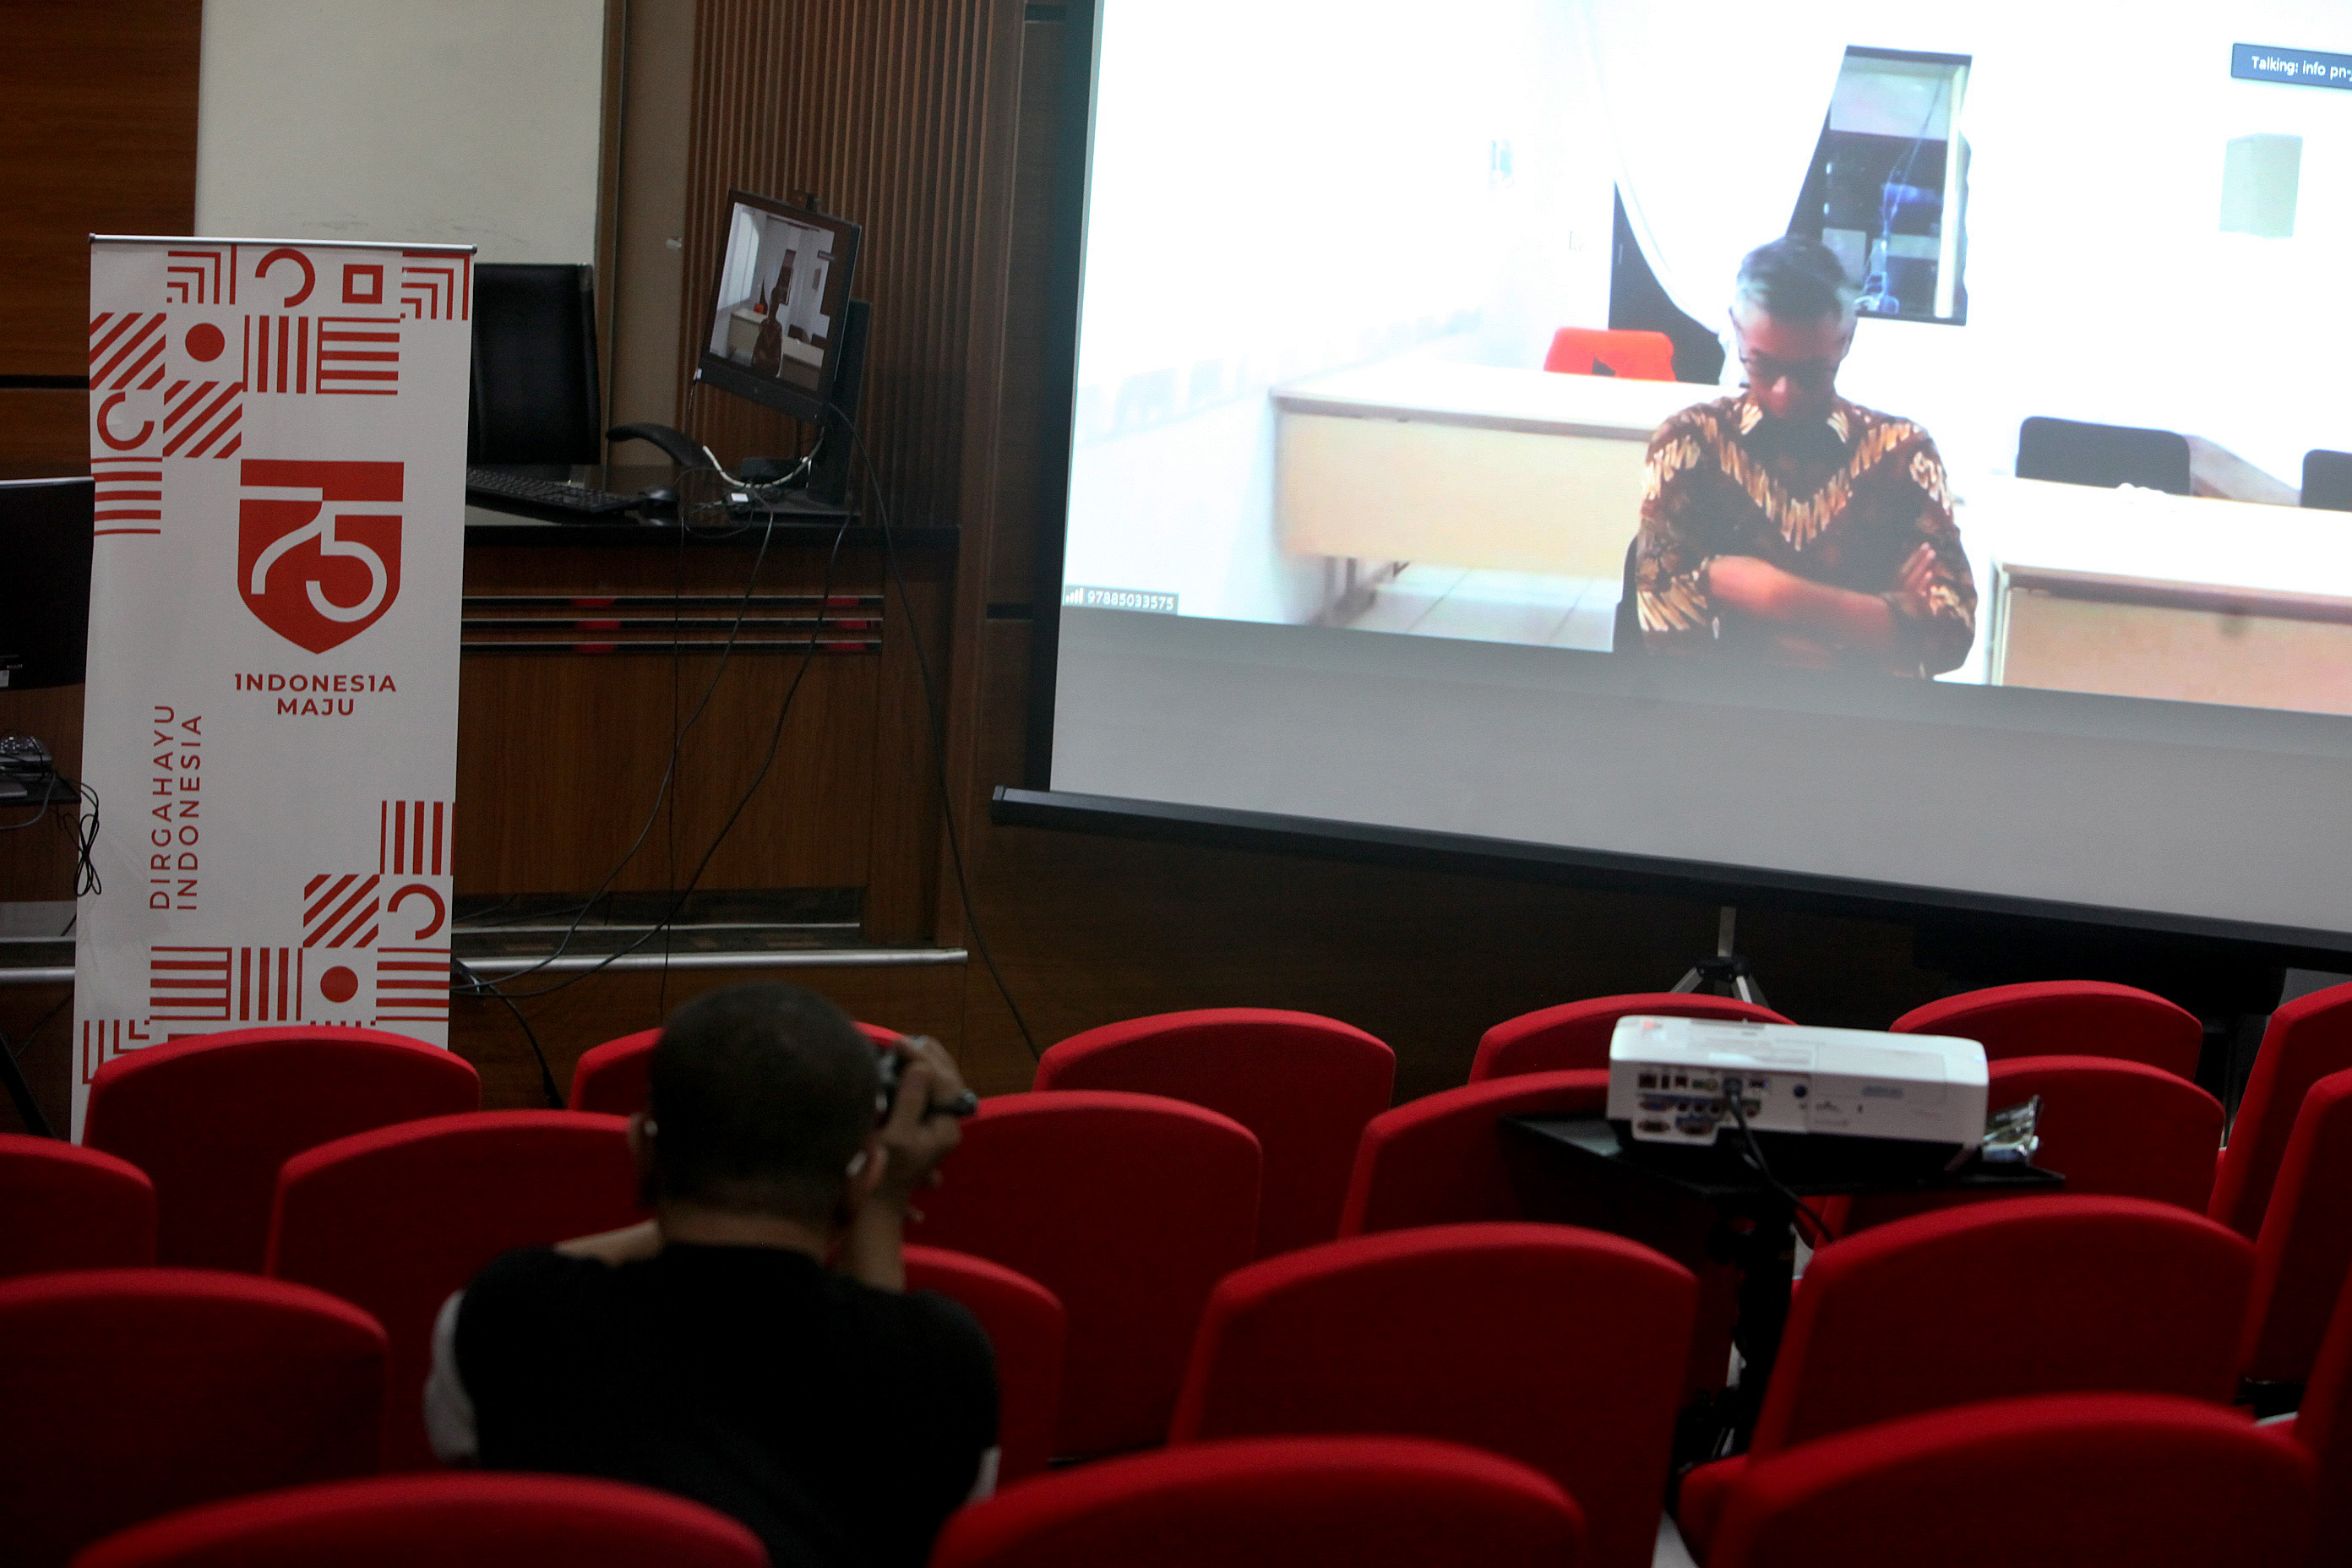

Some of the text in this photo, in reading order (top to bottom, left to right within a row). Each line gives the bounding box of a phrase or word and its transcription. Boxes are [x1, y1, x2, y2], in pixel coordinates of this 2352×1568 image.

[2251, 55, 2299, 76] Talking:
[2303, 60, 2326, 76] info
[277, 698, 354, 716] MAJU
[150, 705, 175, 909] DIRGAHAYU
[177, 716, 202, 910] INDONESIA
